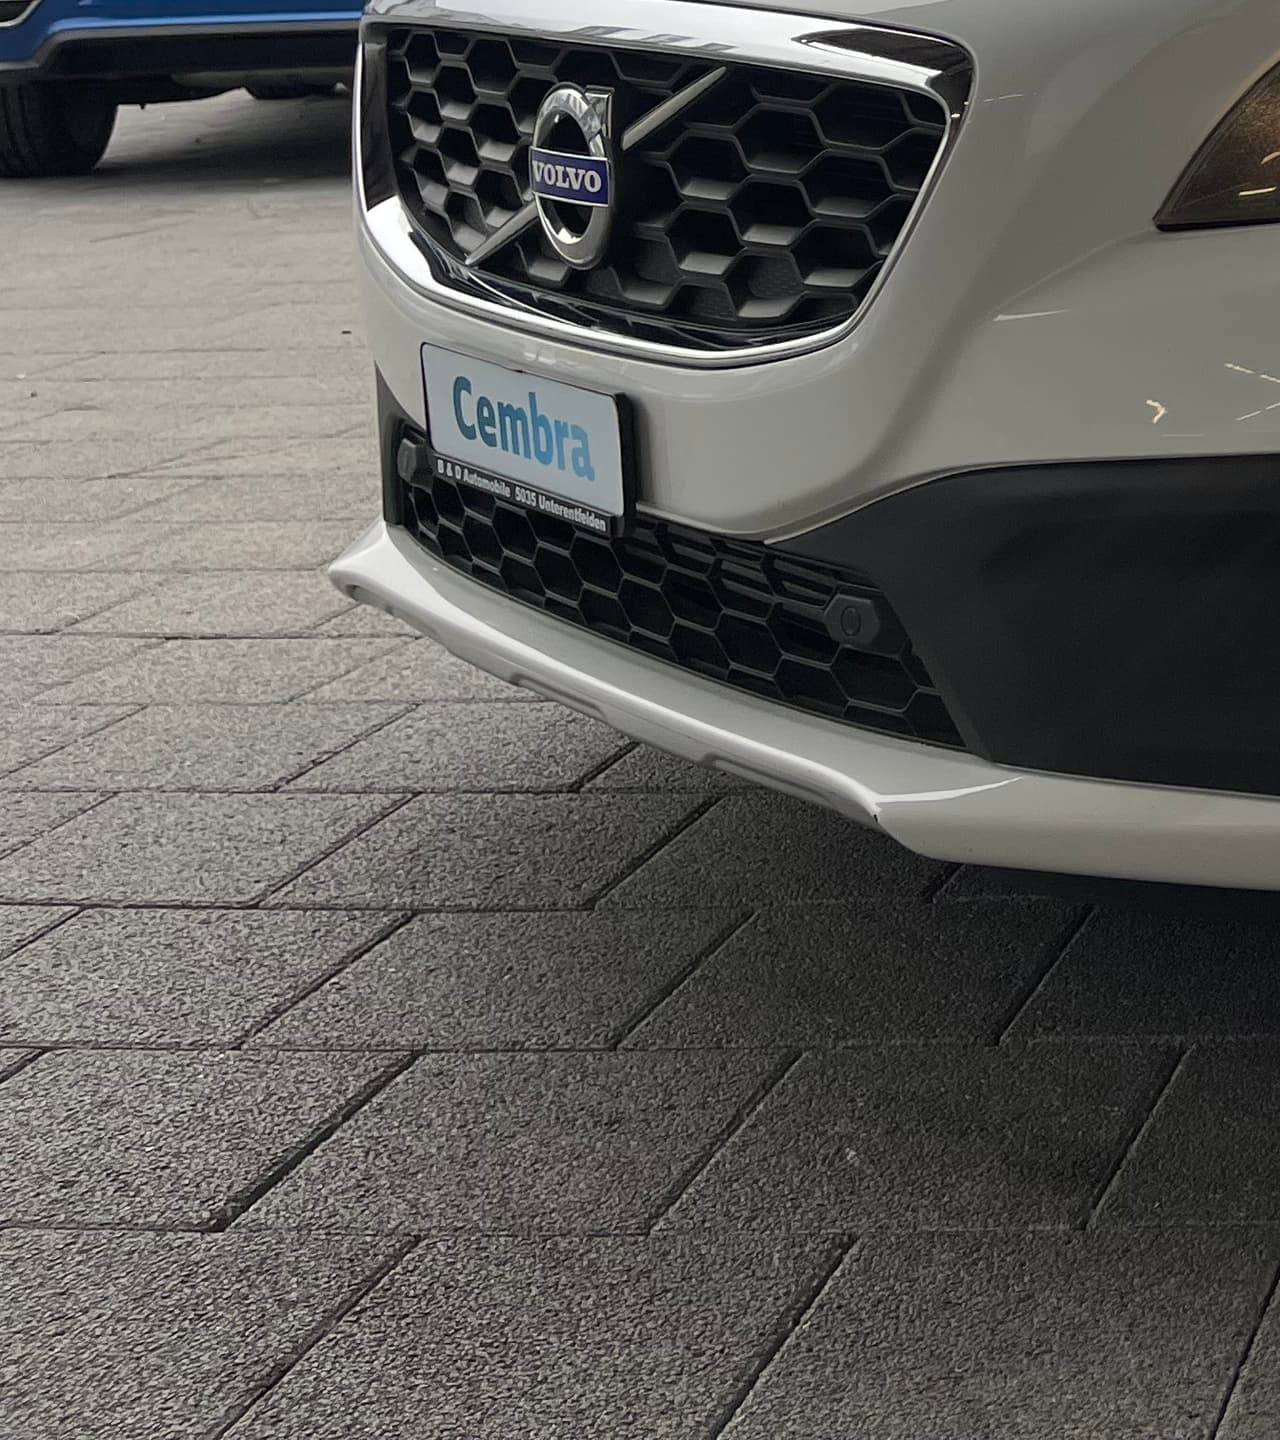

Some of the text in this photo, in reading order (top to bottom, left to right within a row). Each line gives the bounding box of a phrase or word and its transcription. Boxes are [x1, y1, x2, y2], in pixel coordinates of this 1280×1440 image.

[532, 160, 602, 193] VOLVO
[453, 376, 595, 481] Cembra
[463, 469, 511, 498] Automobile
[515, 486, 537, 507] 5035
[538, 491, 606, 532] Unterentfelden
